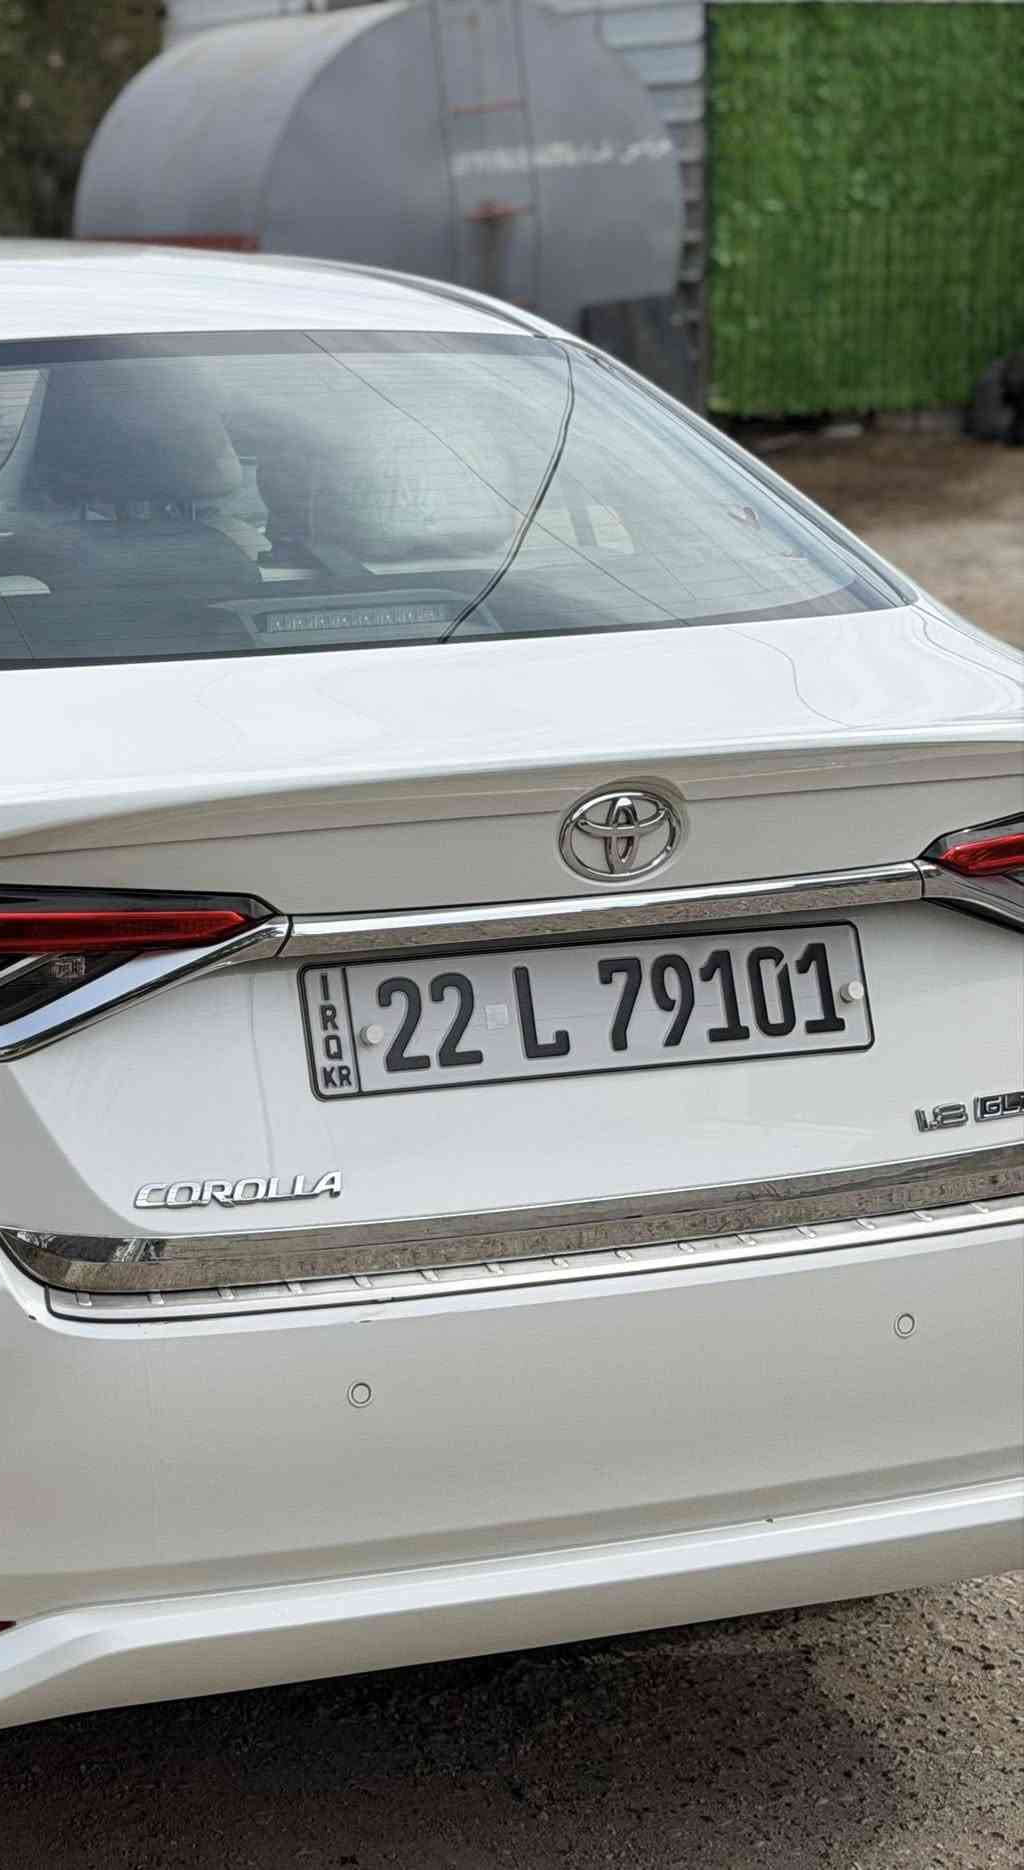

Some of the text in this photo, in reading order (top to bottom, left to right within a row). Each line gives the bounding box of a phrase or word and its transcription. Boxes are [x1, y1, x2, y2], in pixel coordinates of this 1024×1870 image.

[320, 971, 343, 1061] IRQ
[378, 943, 845, 1072] 22 L 79101
[322, 1065, 352, 1089] KR
[915, 1094, 1024, 1132] 1.8 GL
[134, 1170, 342, 1209] COROLLA
